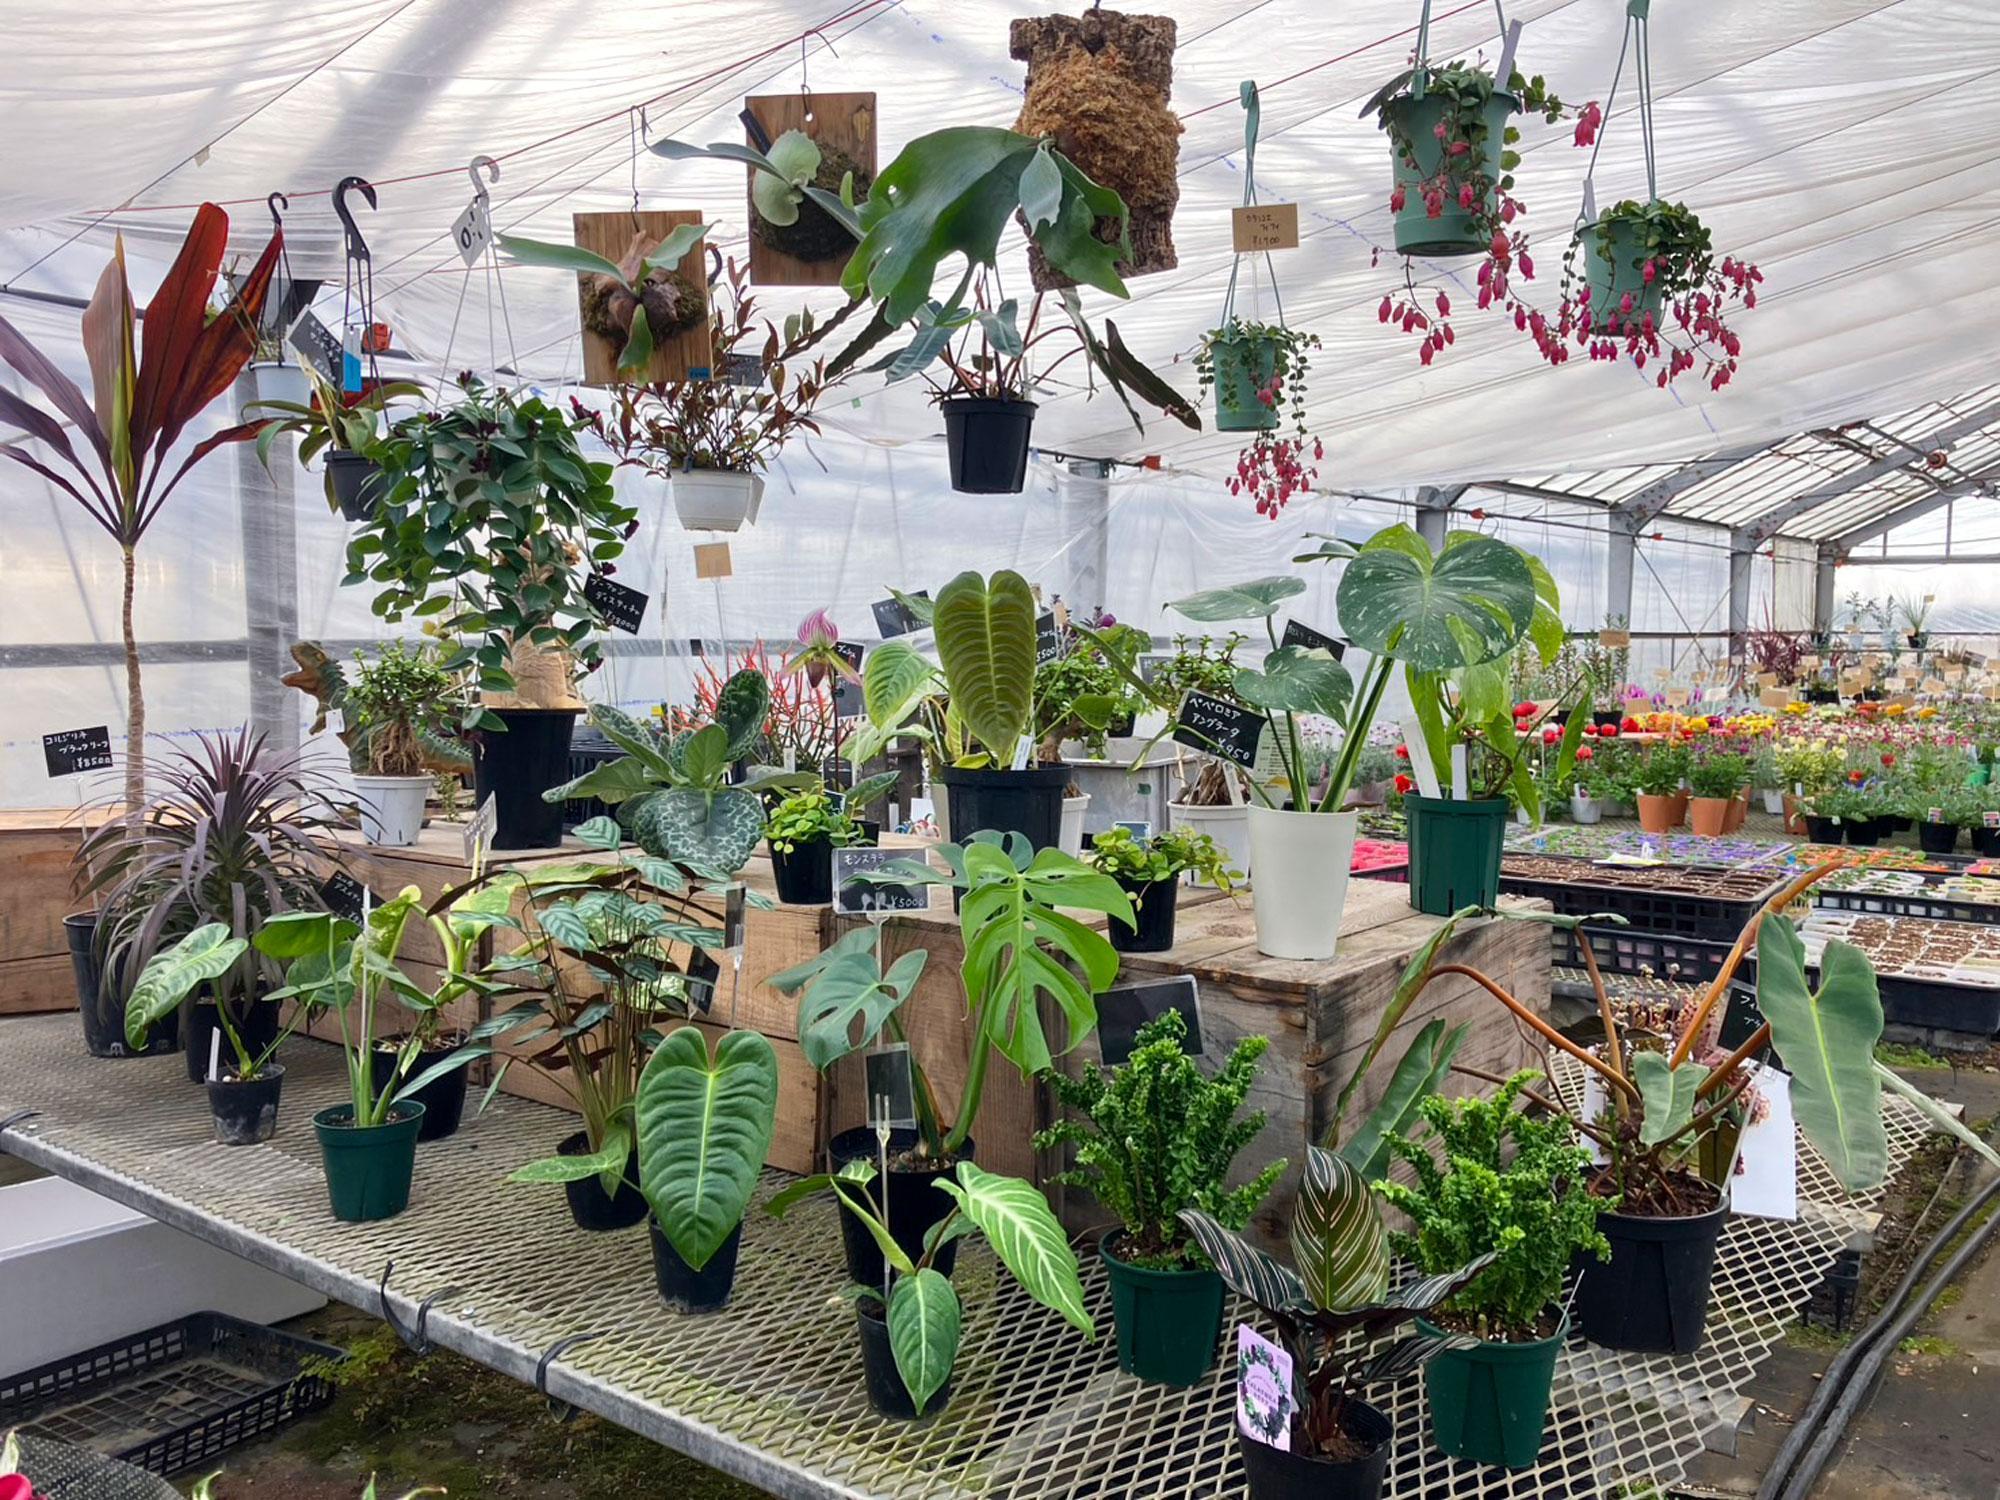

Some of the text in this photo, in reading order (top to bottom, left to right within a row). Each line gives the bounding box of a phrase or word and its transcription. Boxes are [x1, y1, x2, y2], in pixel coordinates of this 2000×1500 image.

[1189, 697, 1242, 720] ペペロミア
[1192, 712, 1241, 738] アングラータ
[76, 756, 112, 769] ¥8500
[890, 895, 926, 908] ¥5000
